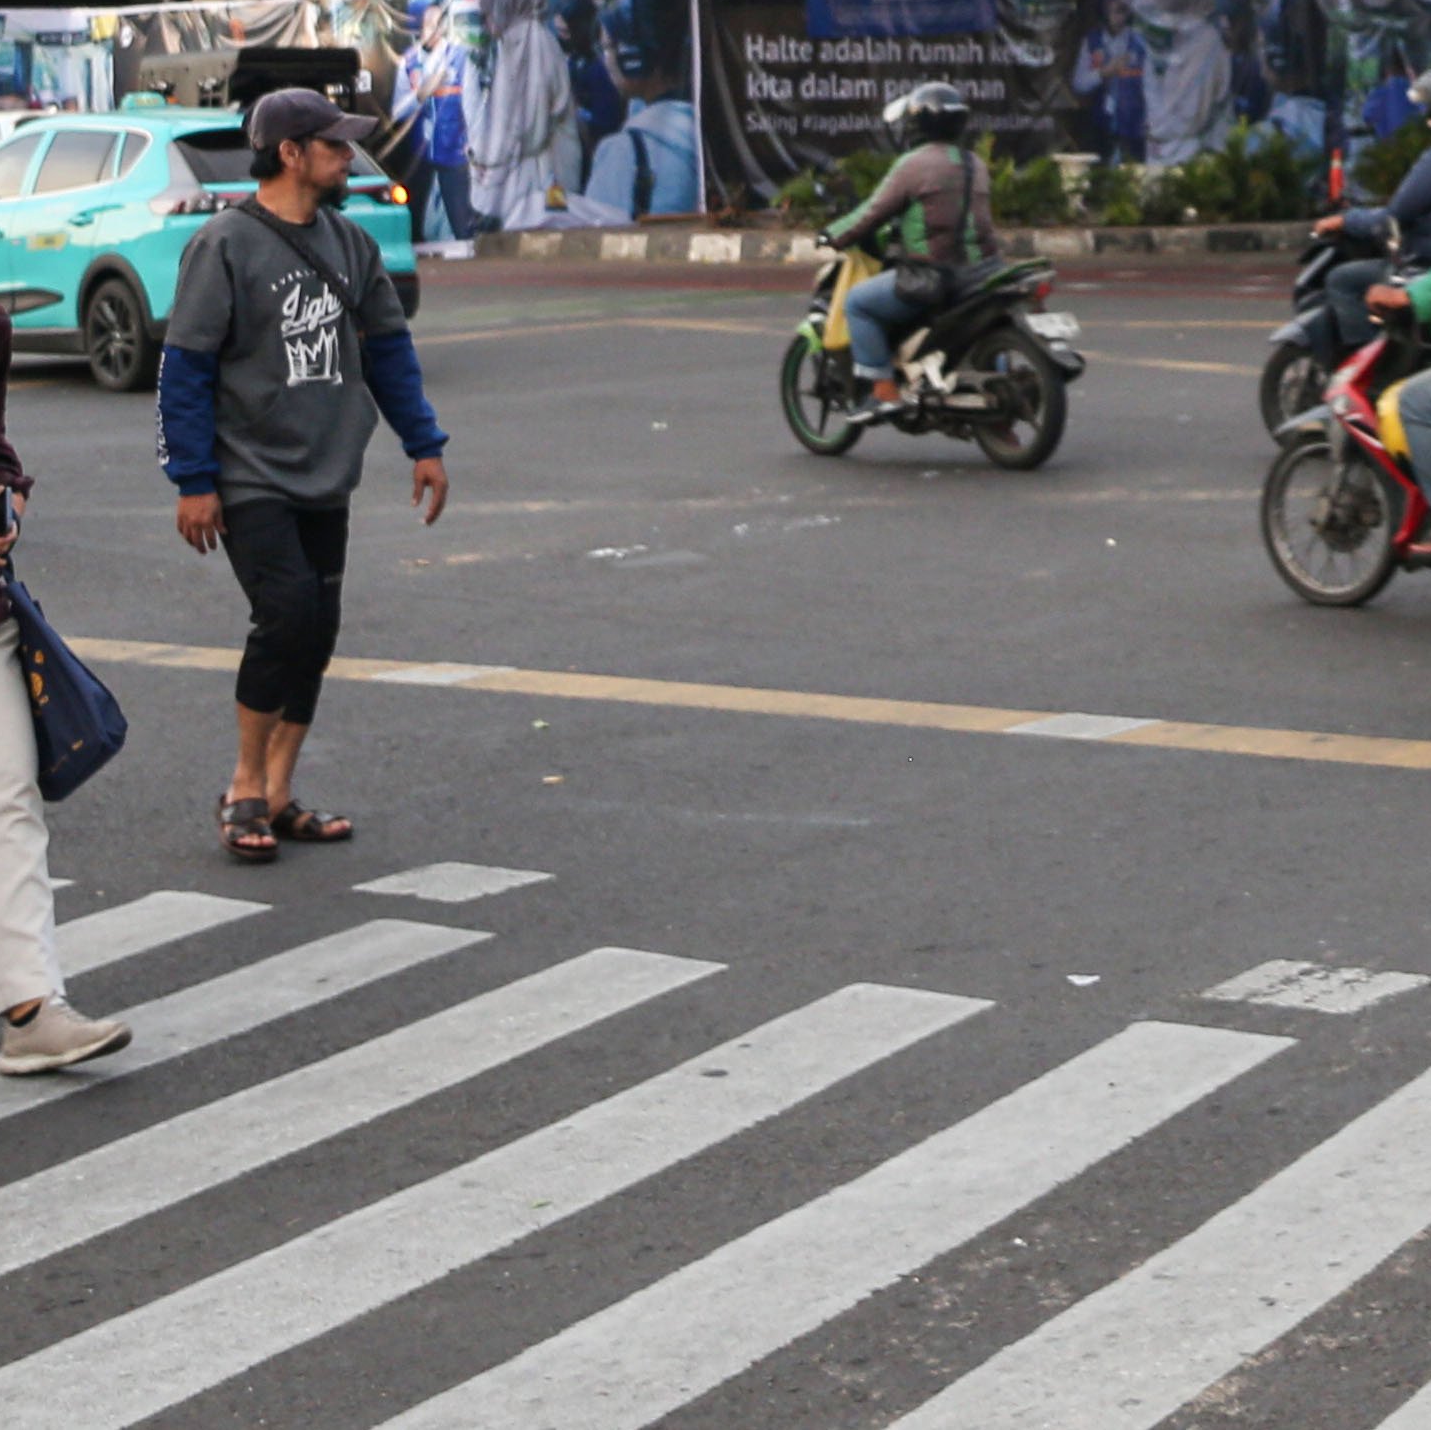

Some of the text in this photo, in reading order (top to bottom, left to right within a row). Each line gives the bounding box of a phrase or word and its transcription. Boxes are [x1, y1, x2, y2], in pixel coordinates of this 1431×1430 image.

[745, 35, 813, 63] Halte
[820, 36, 901, 63] adalah
[908, 36, 984, 63] rumah
[746, 73, 792, 100] kita
[799, 73, 876, 100] dalam
